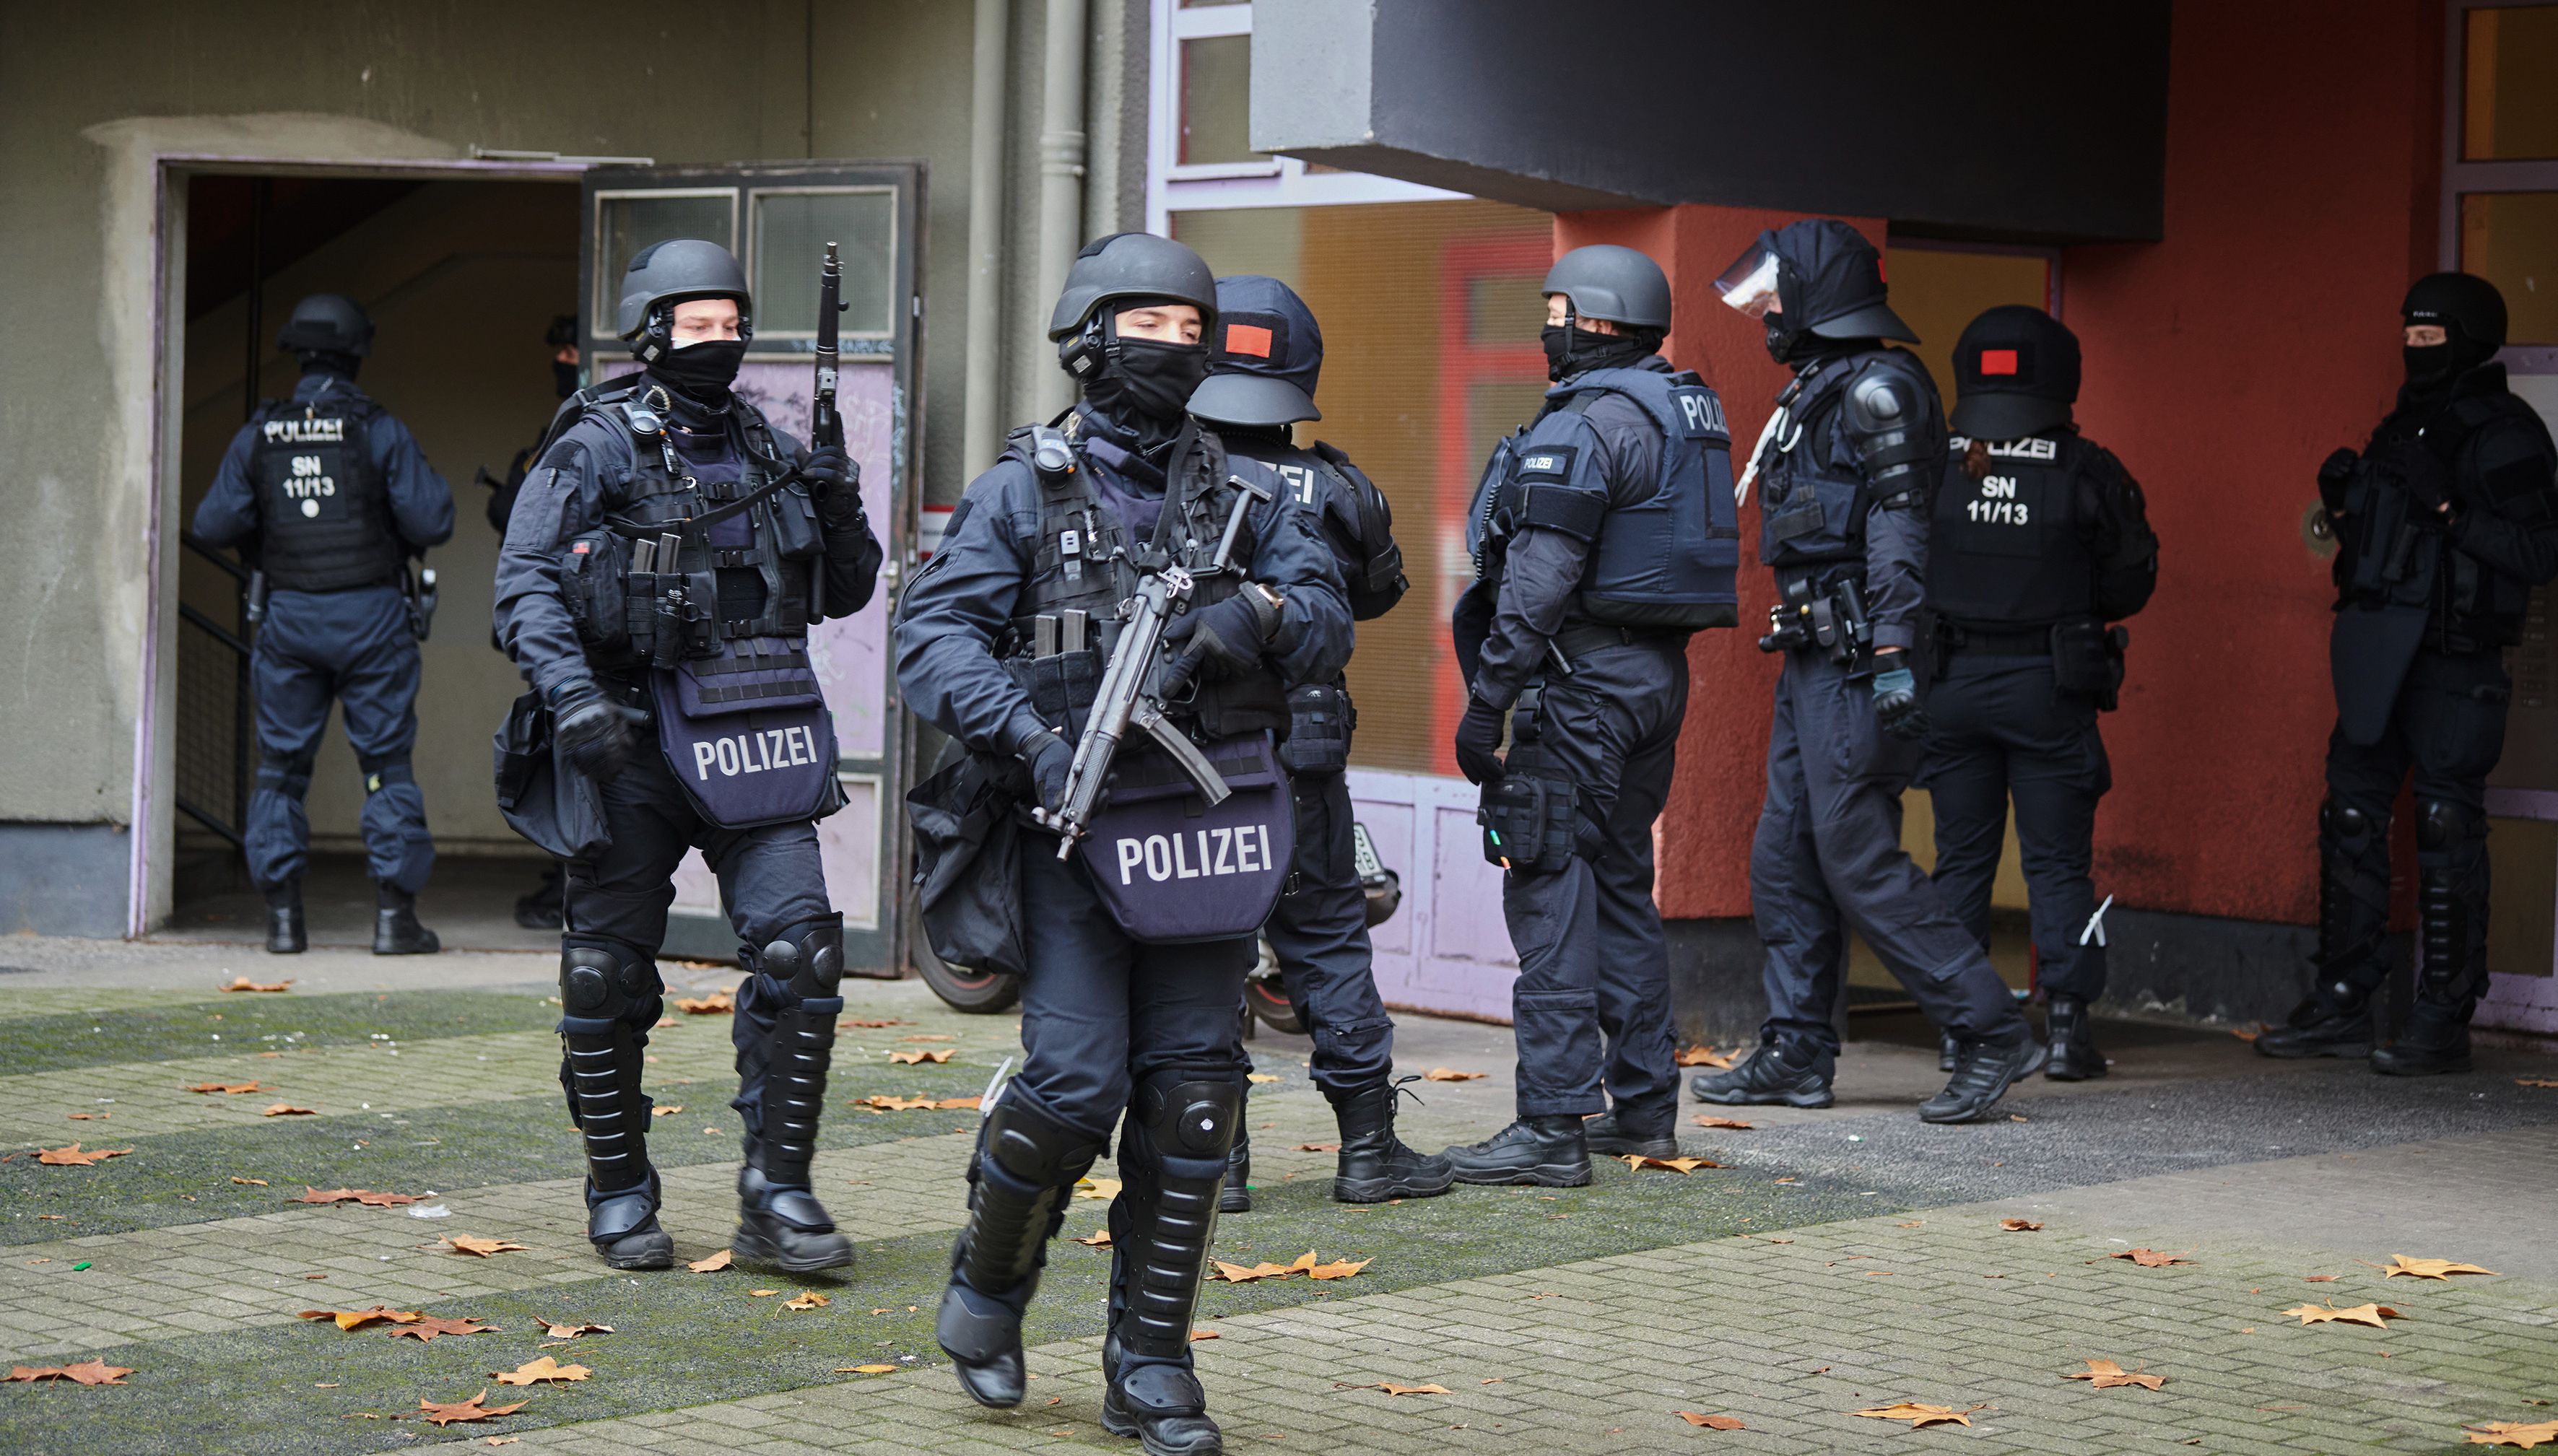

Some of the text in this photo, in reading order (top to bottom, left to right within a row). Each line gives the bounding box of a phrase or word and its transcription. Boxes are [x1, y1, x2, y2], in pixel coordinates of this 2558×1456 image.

[264, 419, 343, 443] POLIZEI
[1949, 437, 2056, 460] PLIZEI
[292, 455, 321, 476] SN
[1523, 457, 1553, 469] POLIZEI
[282, 476, 335, 498] 11/13
[1981, 475, 2017, 499] SN
[1967, 500, 2028, 526] 11/13
[693, 725, 817, 780] POLIZEI
[1117, 825, 1271, 885] POLIZEI
